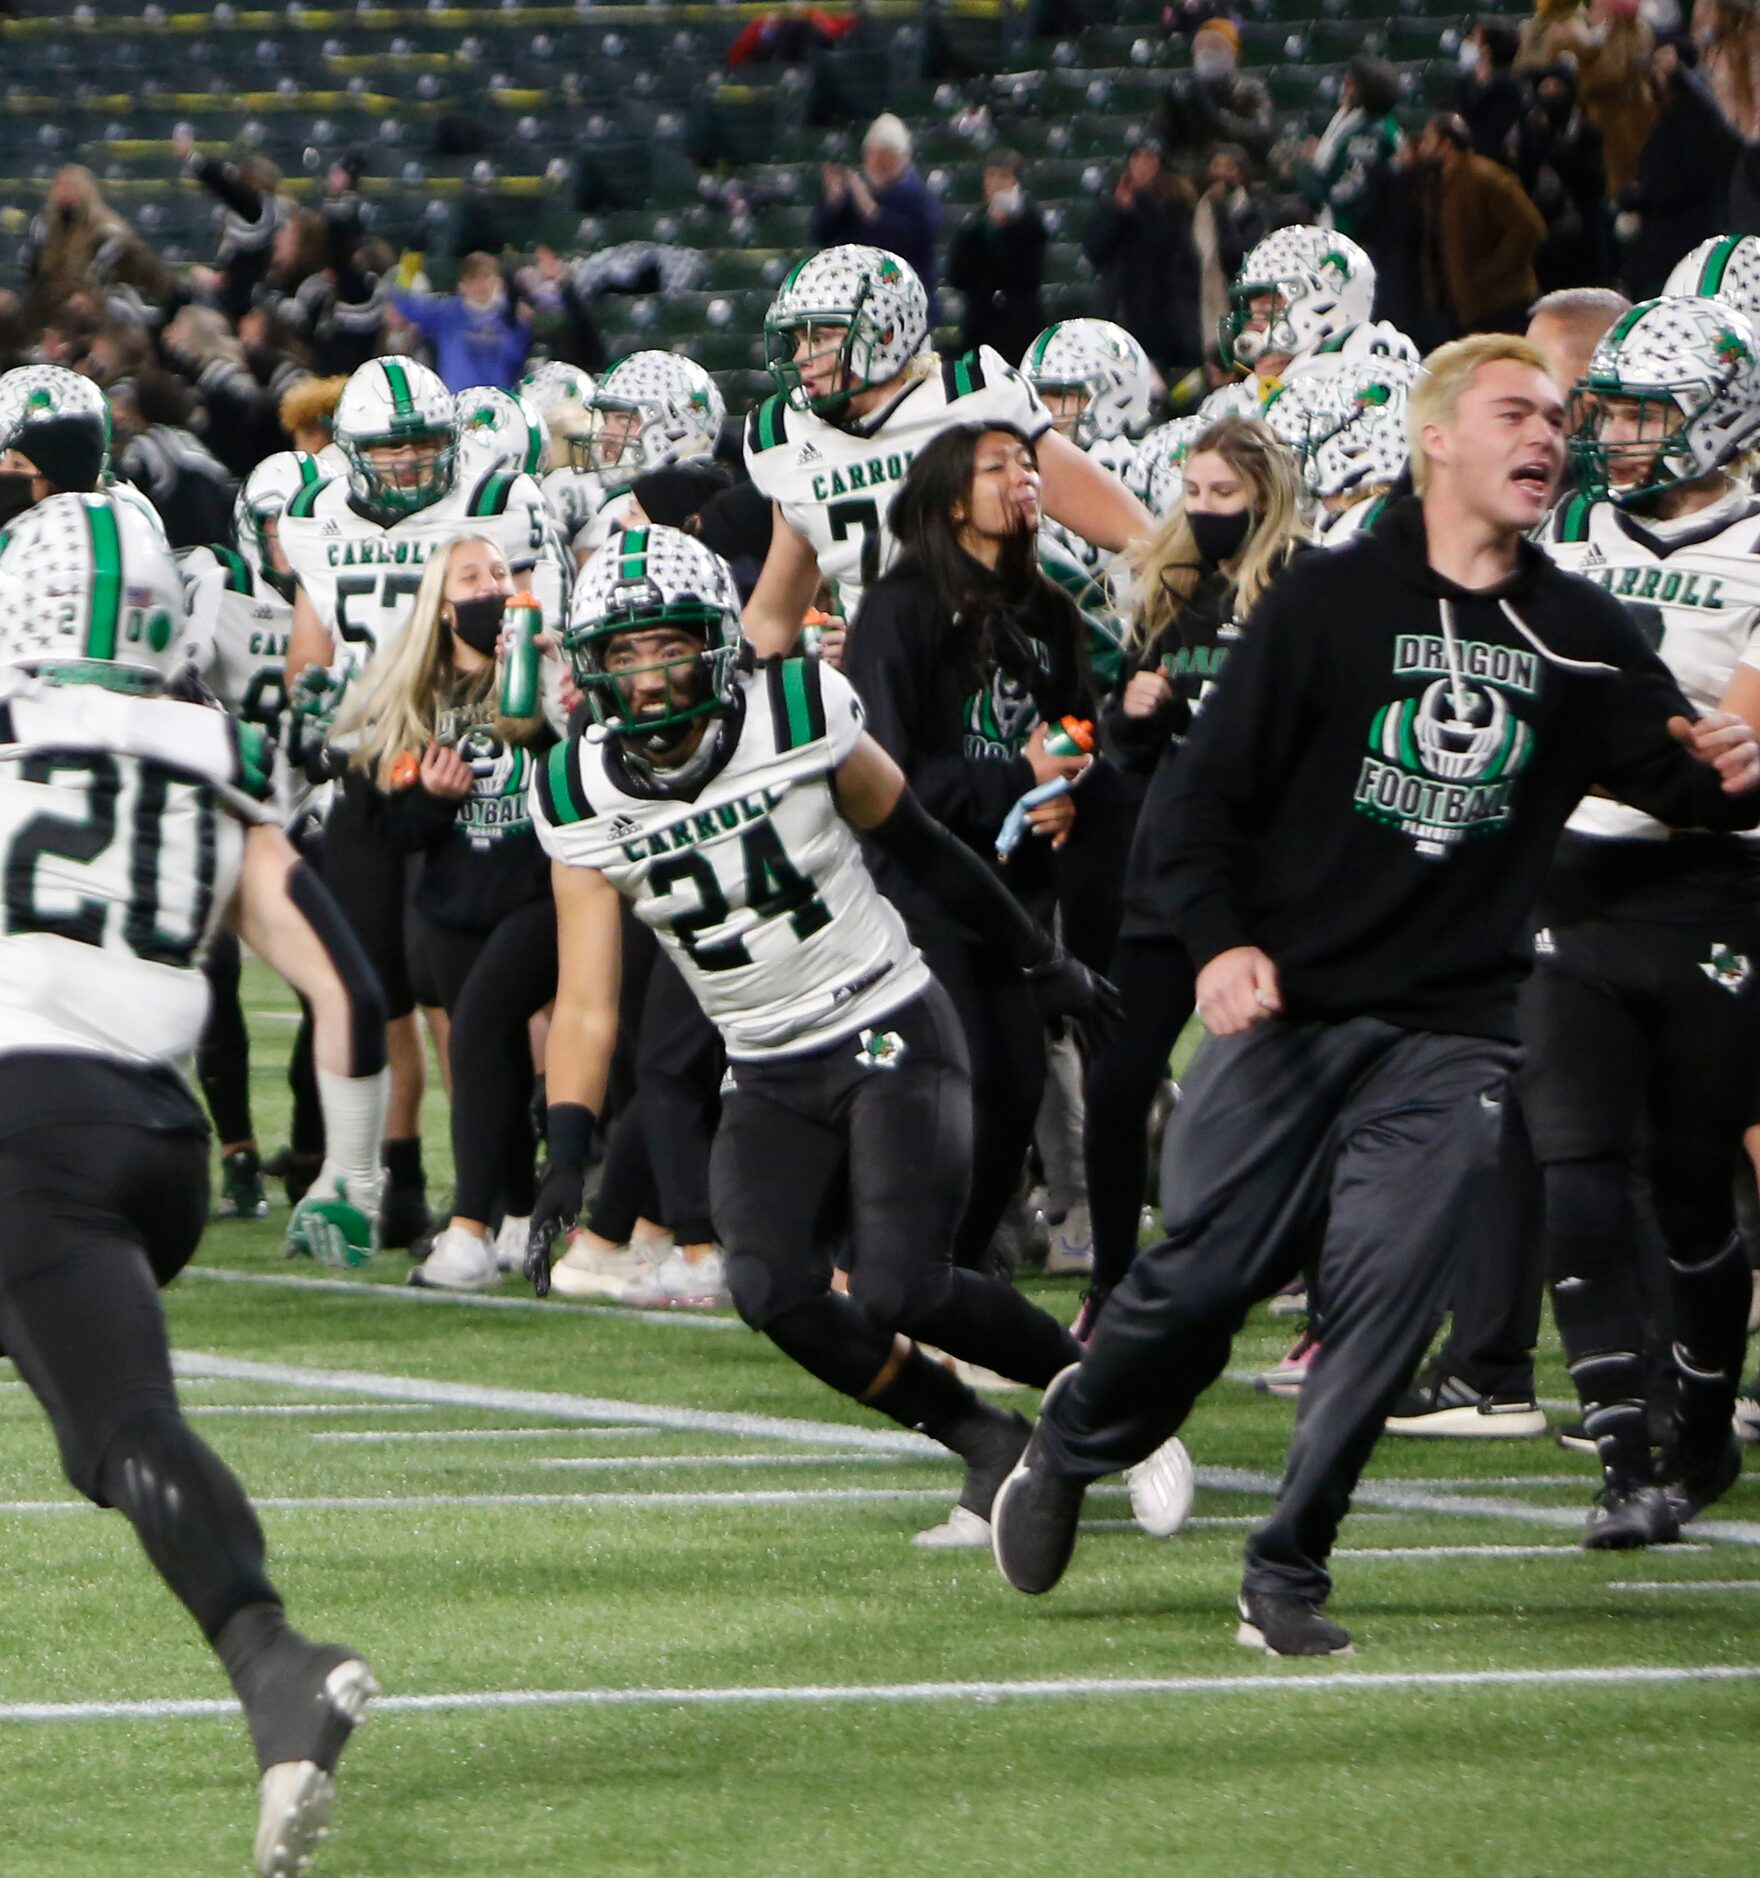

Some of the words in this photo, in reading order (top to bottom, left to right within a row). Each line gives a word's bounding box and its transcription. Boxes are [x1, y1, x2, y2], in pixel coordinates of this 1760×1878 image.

[812, 450, 914, 501] CARRO
[1583, 568, 1724, 609] ARROLL
[1392, 634, 1539, 696] DRAGON
[3, 746, 217, 969] 20
[620, 787, 786, 863] CARROLL
[647, 816, 833, 972] 24
